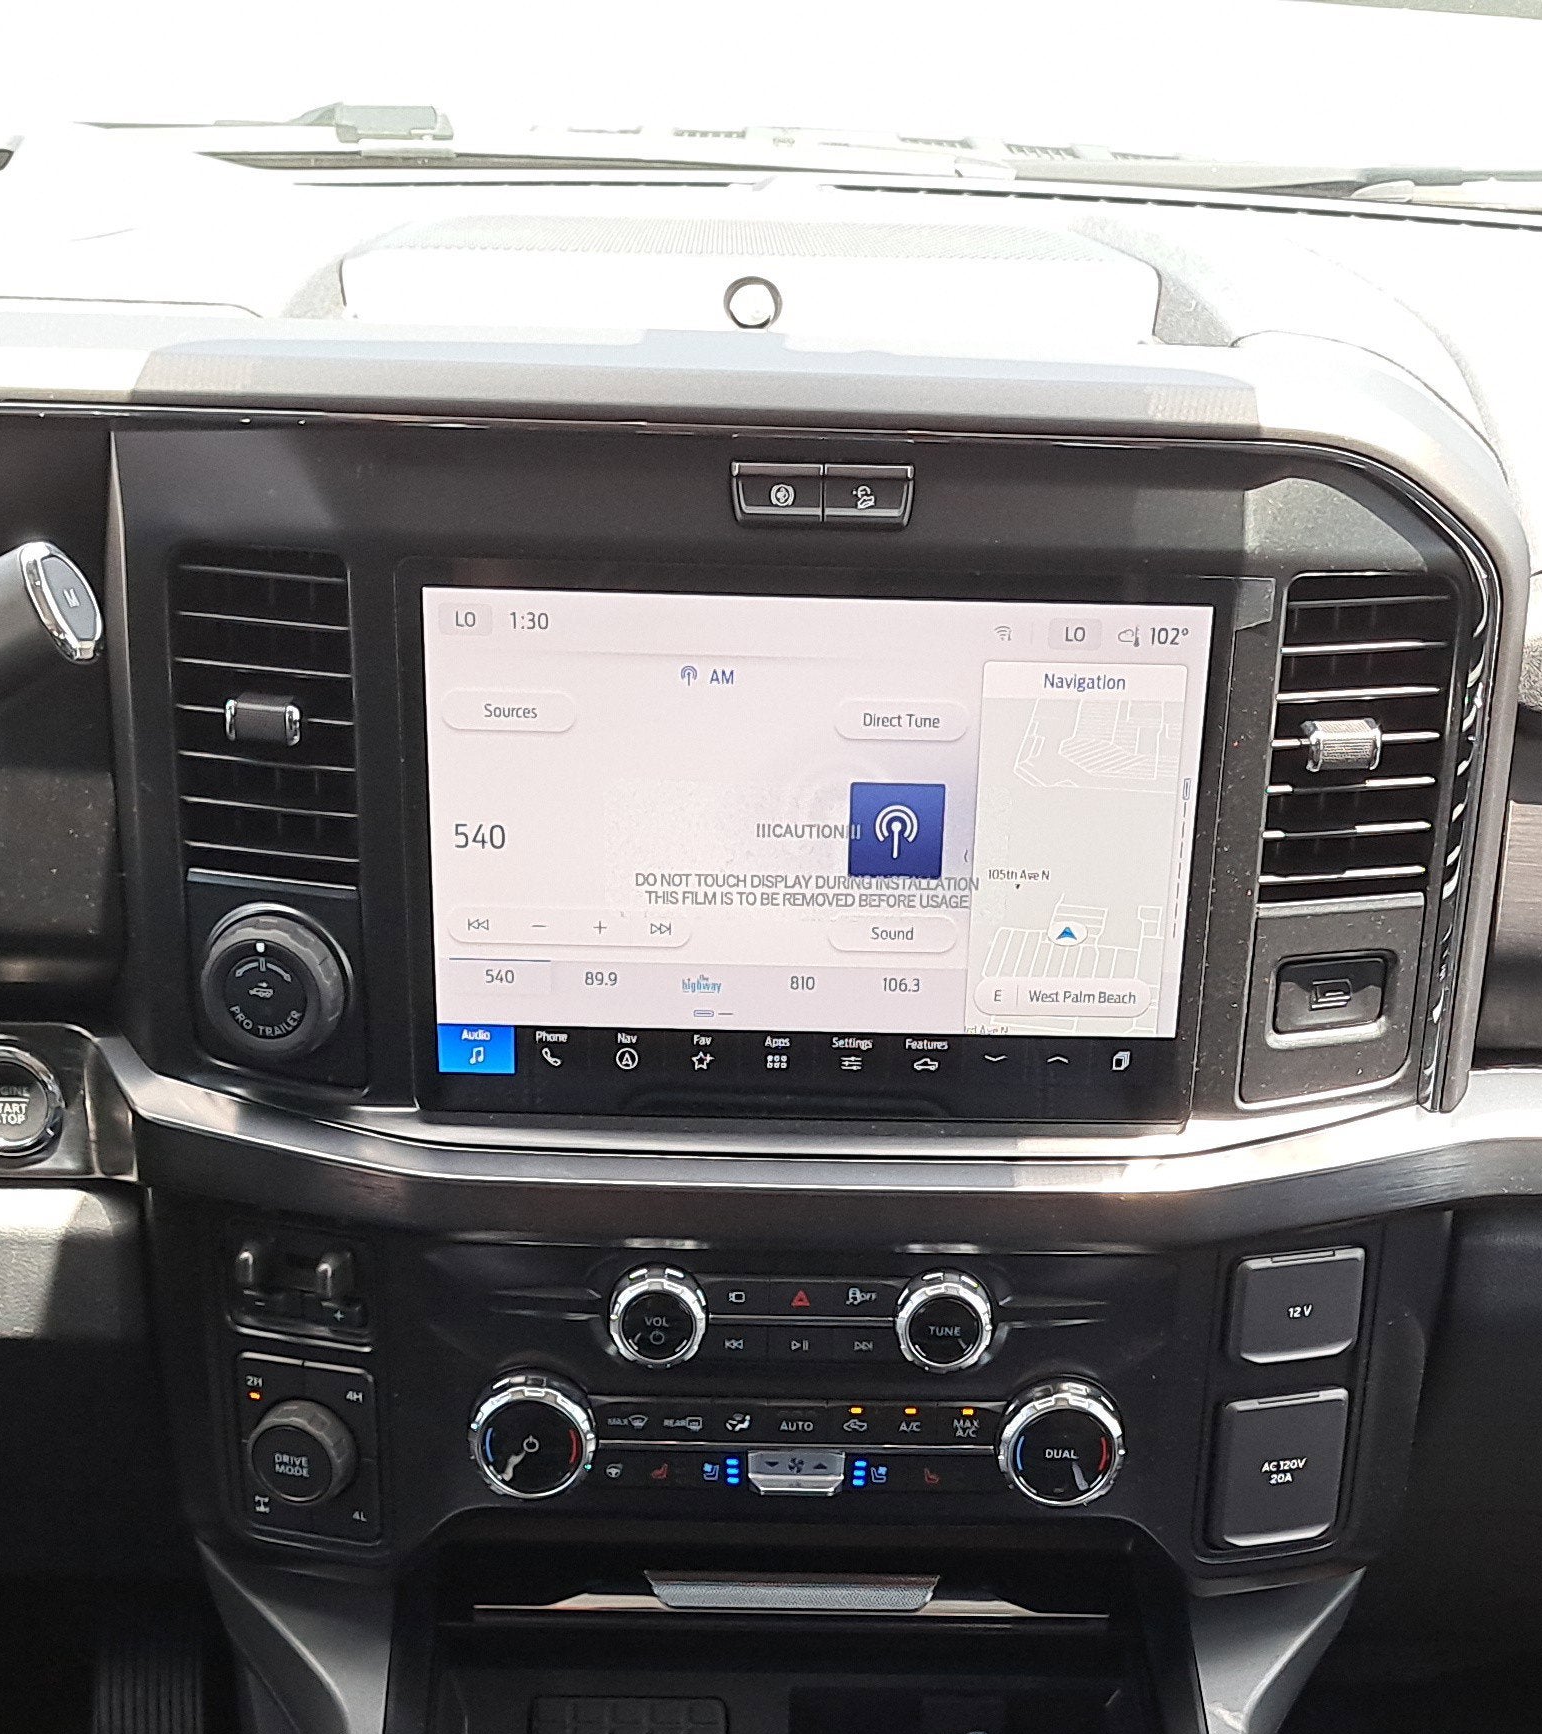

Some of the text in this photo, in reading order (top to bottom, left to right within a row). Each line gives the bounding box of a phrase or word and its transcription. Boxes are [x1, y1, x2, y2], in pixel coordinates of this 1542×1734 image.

[456, 610, 476, 628] LO
[509, 611, 549, 631] 1:30
[1064, 626, 1086, 642] LO
[1150, 626, 1189, 646] 102°
[709, 669, 734, 685] AM
[1043, 673, 1126, 692] Navigation
[483, 703, 538, 719] Sources
[862, 712, 940, 729] Direct Tune
[454, 823, 506, 849] 540
[635, 873, 979, 891] DO NOT TOUCH DISPLAY DURING INSTALLATION
[988, 869, 1050, 881] 105th Ave N
[645, 890, 970, 909] THIS FILM IS TO BE REMOVED BEFORE USAGE
[870, 926, 914, 941] Sound
[485, 969, 515, 984] 540
[584, 971, 618, 987] 89.9
[790, 975, 815, 991] 810
[681, 977, 722, 994] highway
[883, 977, 921, 992] 106.3
[994, 989, 1002, 1002] E
[1029, 990, 1137, 1005] West Palm Beach
[229, 1004, 303, 1038] PRO TRAILER
[461, 1029, 492, 1041] Audio
[535, 1030, 568, 1043] Phone
[617, 1032, 638, 1044] Nav
[693, 1034, 712, 1046] Fav
[764, 1036, 790, 1049] Apps
[832, 1037, 874, 1050] Settings
[905, 1038, 949, 1050] Features
[1288, 1304, 1313, 1318] 12 V
[644, 1316, 669, 1328] VOL
[928, 1325, 961, 1337] TUNE
[245, 1375, 263, 1388] 2H
[345, 1390, 363, 1403] 4H
[607, 1417, 629, 1426] MAX
[779, 1420, 814, 1432] AUTO
[899, 1420, 922, 1432] A/C
[953, 1418, 980, 1430] MAX
[955, 1427, 978, 1439] A/C
[274, 1453, 309, 1467] DRIVE
[1045, 1448, 1077, 1460] DUAL
[274, 1464, 310, 1478] MODE
[1261, 1457, 1307, 1473] AC 120V
[1269, 1473, 1293, 1485] 20A
[352, 1511, 367, 1522] 4L
